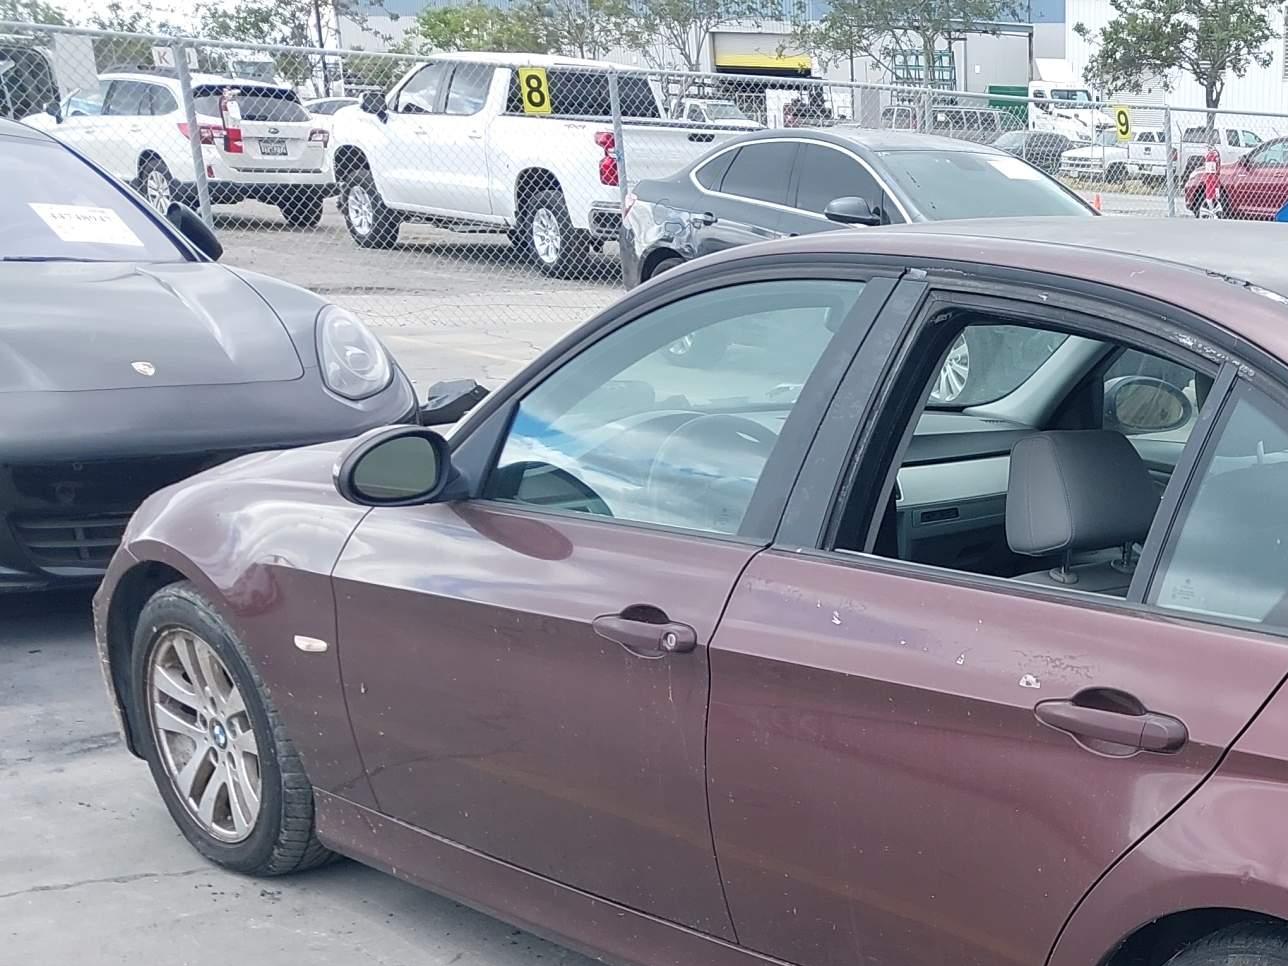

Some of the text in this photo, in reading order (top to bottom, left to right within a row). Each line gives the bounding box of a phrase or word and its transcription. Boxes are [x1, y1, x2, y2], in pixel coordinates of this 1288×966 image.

[157, 51, 170, 65] K
[525, 74, 546, 108] 8
[1117, 110, 1129, 136] 9
